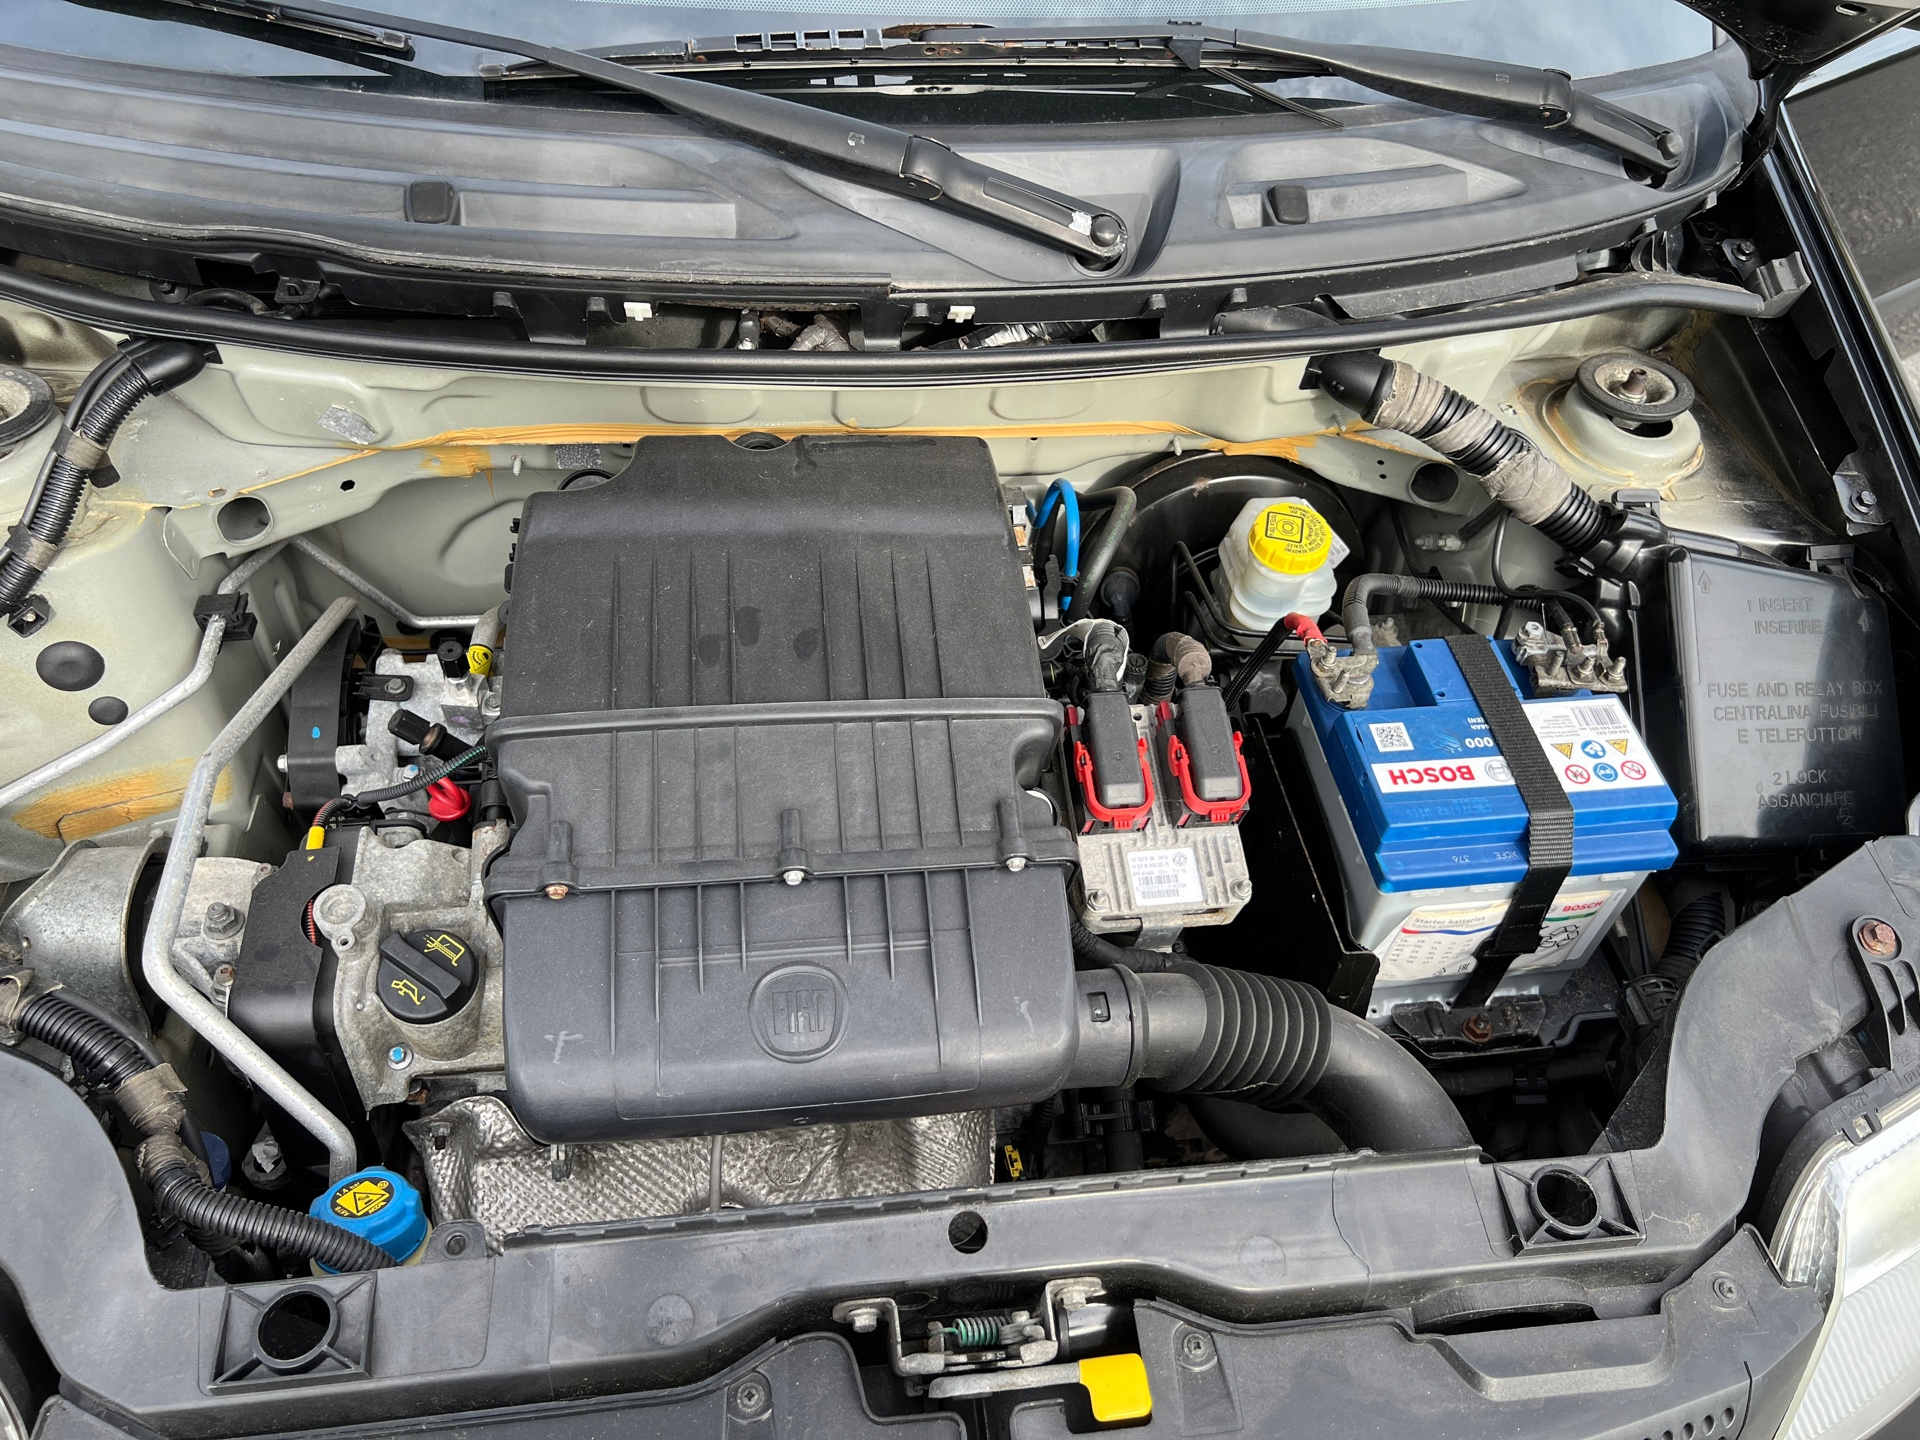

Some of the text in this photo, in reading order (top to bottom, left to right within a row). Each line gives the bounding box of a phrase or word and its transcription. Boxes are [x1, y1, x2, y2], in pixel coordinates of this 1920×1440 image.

[1758, 596, 1814, 612] INSERT
[1754, 618, 1823, 635] INSERIRE
[1707, 680, 1884, 698] FUSE AND RELAY BOX
[1713, 704, 1880, 722] CENTRALINA FUSIBILI
[1738, 727, 1862, 744] E TELERUTTORI
[1388, 765, 1476, 786] BOSCH
[1785, 769, 1828, 785] LOCK
[1757, 791, 1855, 809] AGGANCIARE
[1452, 854, 1471, 863] 376
[1562, 900, 1604, 912] BOSCH
[1413, 916, 1486, 925] Starter batteries
[771, 988, 829, 1036] FIAT
